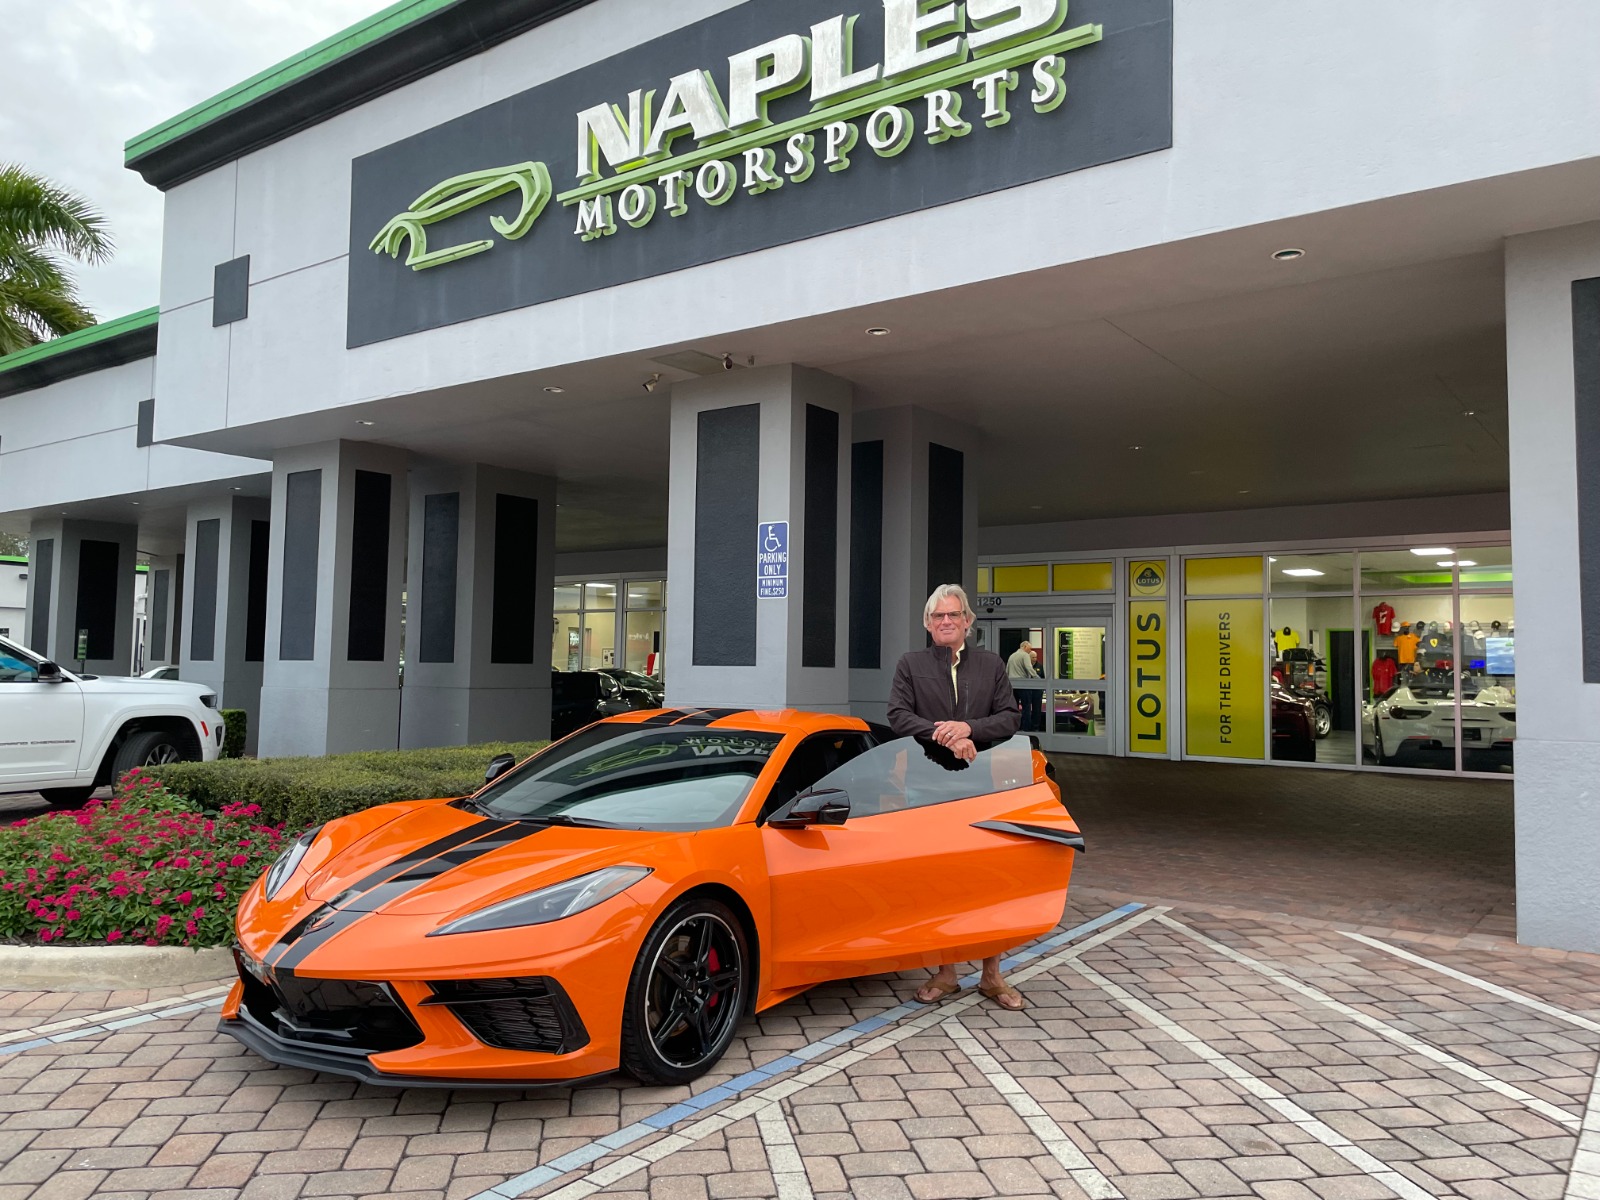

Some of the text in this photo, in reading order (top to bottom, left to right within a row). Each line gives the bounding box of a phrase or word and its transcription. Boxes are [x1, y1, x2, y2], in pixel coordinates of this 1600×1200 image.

[574, 54, 1058, 235] MOTORSPORTS
[759, 552, 787, 564] PARKING
[764, 564, 781, 576] ONLY
[762, 579, 784, 587] MINIMUM
[977, 597, 1002, 606] 1250
[1137, 612, 1161, 741] LOTUS
[1219, 612, 1232, 744] FOR THE DRIVERS
